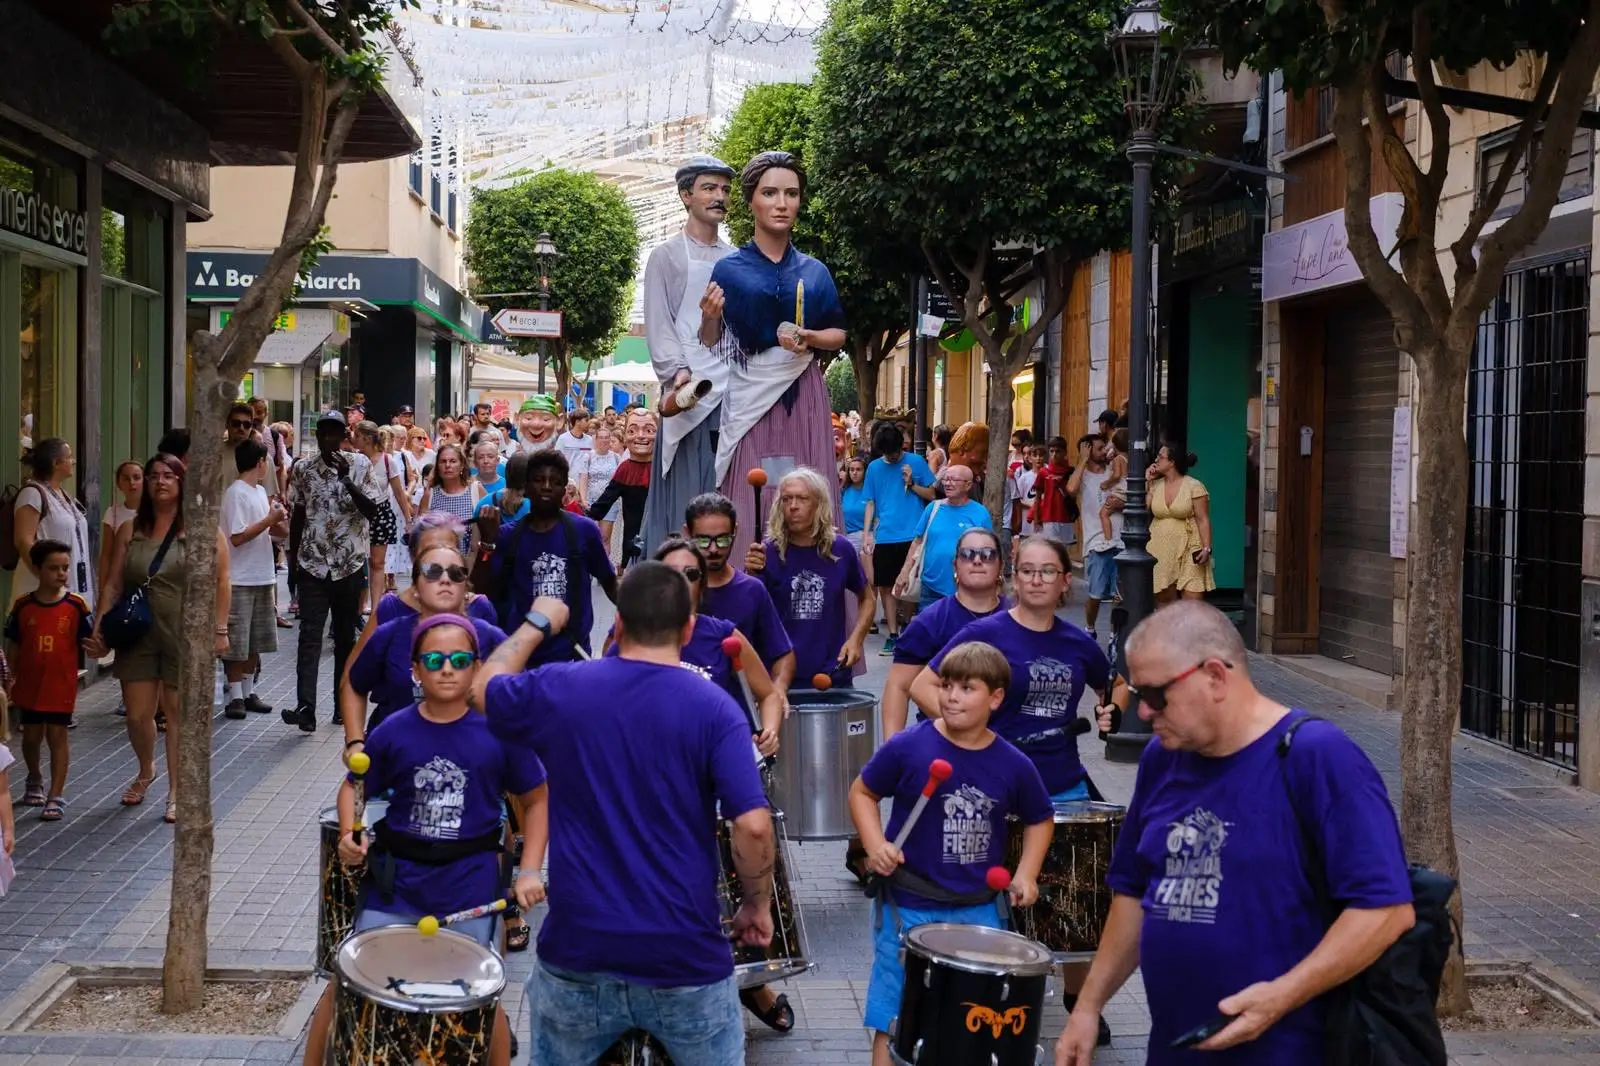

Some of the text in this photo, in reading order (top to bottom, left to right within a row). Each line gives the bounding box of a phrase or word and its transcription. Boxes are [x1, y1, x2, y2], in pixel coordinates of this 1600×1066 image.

[488, 333, 503, 341] ATM
[39, 635, 54, 653] 19
[1024, 692, 1069, 711] FIERES
[1035, 706, 1052, 717] INCA
[409, 803, 463, 829] FIERES
[420, 826, 441, 838] INCA
[943, 832, 991, 854] FIERES
[1155, 877, 1220, 908] FIERES
[1167, 906, 1193, 922] INCA
